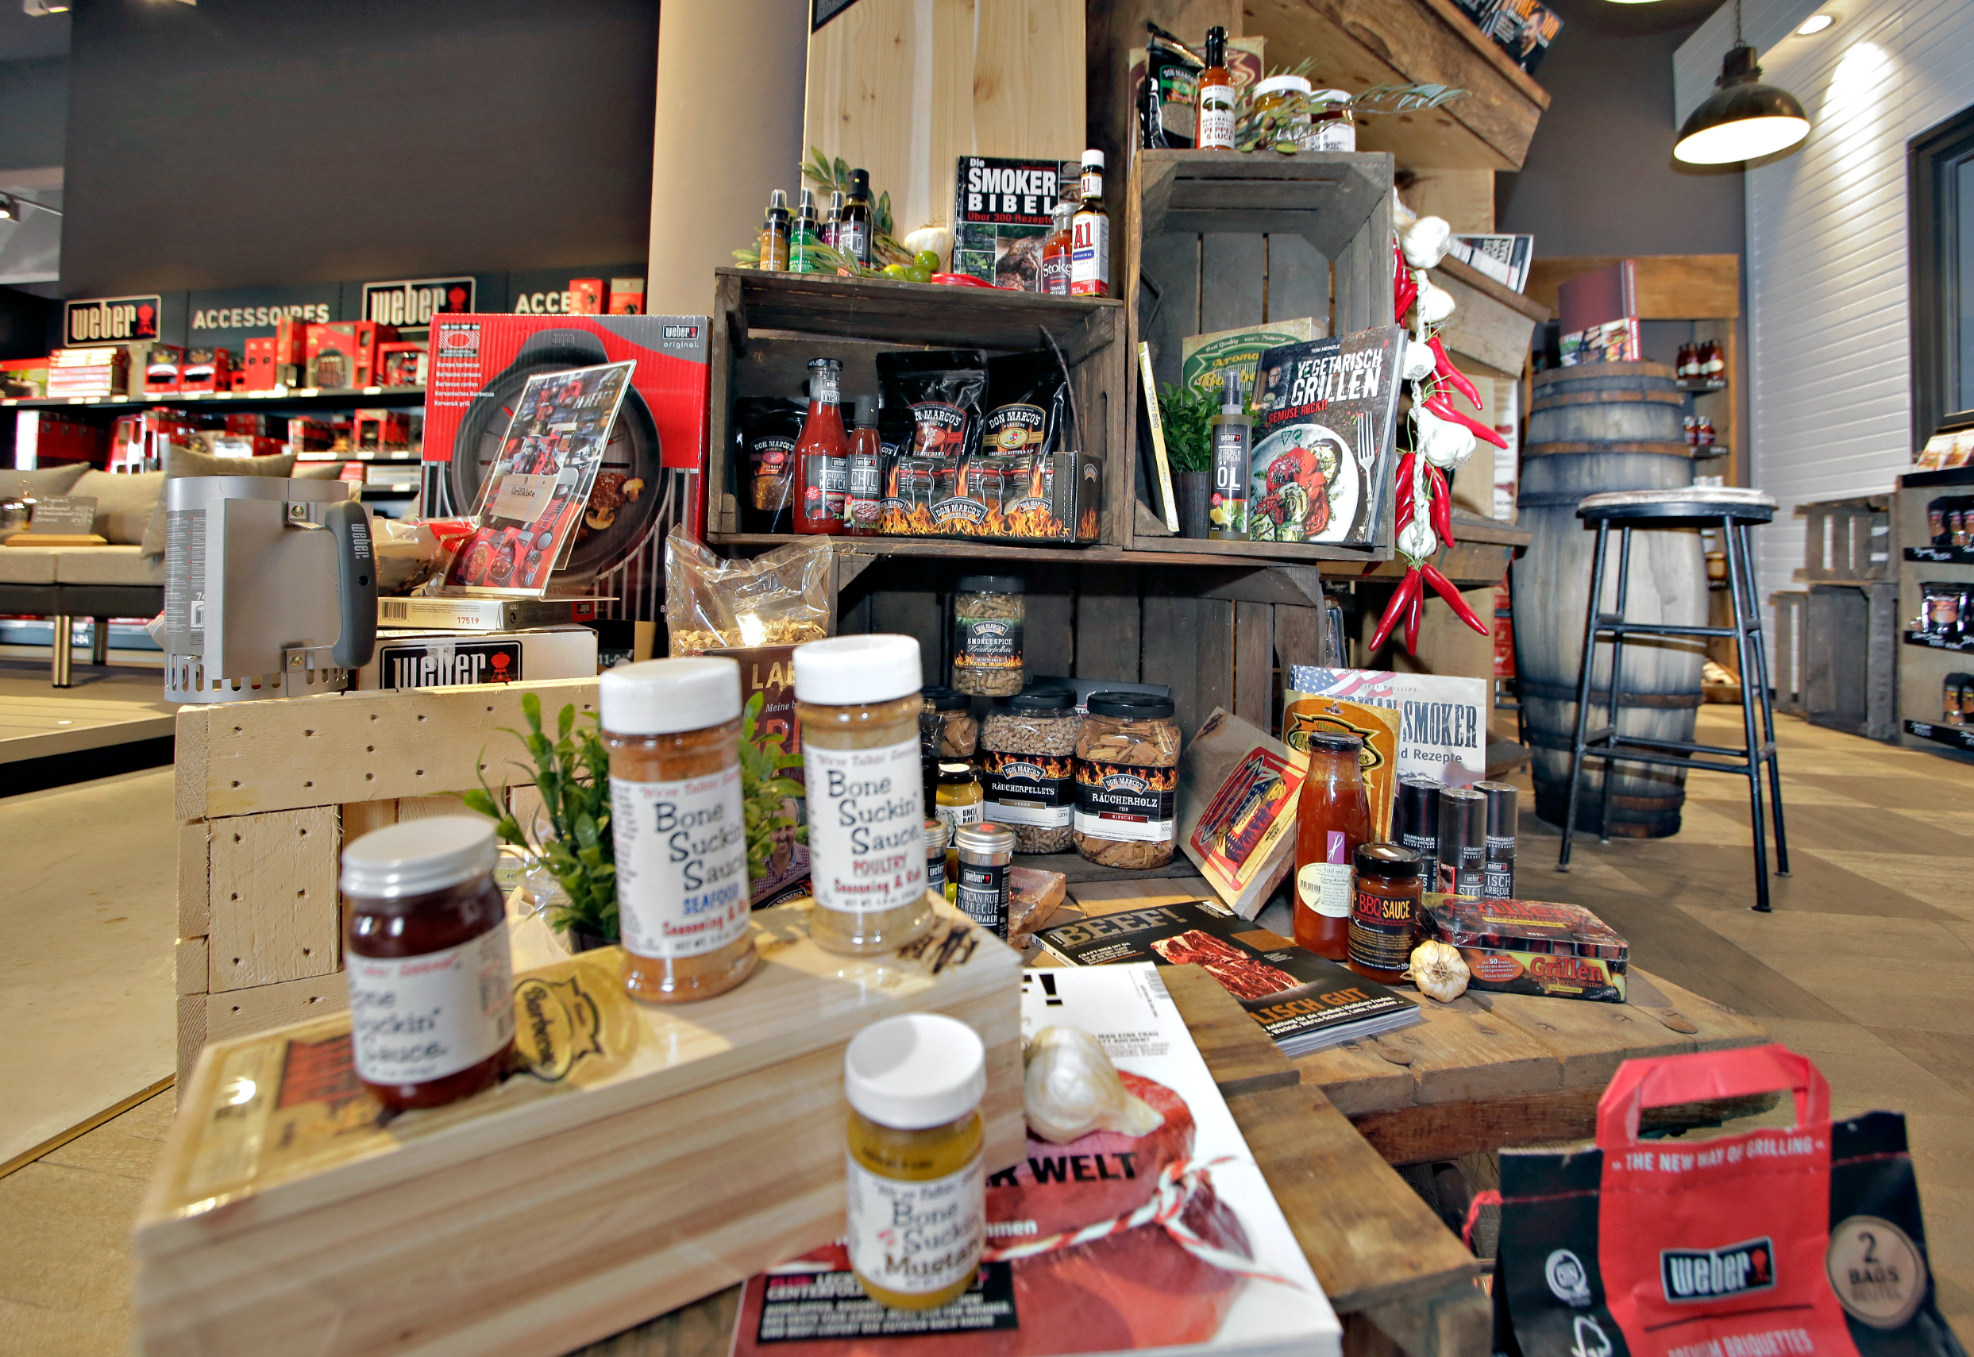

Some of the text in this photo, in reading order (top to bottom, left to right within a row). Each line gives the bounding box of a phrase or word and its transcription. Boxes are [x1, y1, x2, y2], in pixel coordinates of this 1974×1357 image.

[970, 158, 985, 167] Die
[968, 168, 1056, 196] SMOKER
[968, 193, 1054, 215] BIBEL
[968, 211, 990, 221] Über
[994, 213, 1012, 222] 300
[371, 284, 445, 325] weber
[72, 303, 137, 341] weber
[192, 305, 330, 331] ACCESSOIRES
[665, 326, 690, 338] weber
[1219, 339, 1239, 350] Quality
[1261, 334, 1287, 342] Natural
[1212, 352, 1260, 371] Aroma
[1298, 347, 1384, 378] VEGETARISCH
[1291, 366, 1382, 407] GRILLEN
[924, 410, 962, 427] MARCO'S
[988, 411, 1042, 430] DON MARCO'S
[1217, 460, 1241, 488] ÖL
[936, 504, 982, 518] DON MARCO'S
[350, 523, 370, 559] weber
[457, 616, 480, 625] 17519
[993, 638, 1013, 646] SPICE
[393, 653, 487, 689] weber
[1383, 685, 1418, 693] PHILLIPS
[765, 702, 788, 714] Meine
[1402, 699, 1478, 749] SMOKER
[1413, 748, 1463, 765] Rezepte
[1006, 764, 1042, 779] DON MARCO'S
[827, 769, 892, 798] Bone
[991, 782, 1056, 797] RÄUCHERPELLETS
[1106, 776, 1145, 791] DON MARCO'S
[838, 791, 920, 828] Suckin'
[1092, 793, 1158, 808] RÄUCHERHOLZ
[653, 801, 725, 834] Bone
[852, 852, 908, 877] POULTRY
[833, 878, 889, 895] Seasoning
[894, 875, 903, 889] &
[965, 871, 985, 882] weber
[683, 882, 741, 916] SEAFOOD
[958, 888, 999, 905] AFRICAN RUB
[958, 900, 998, 915] BARBECUE
[662, 914, 725, 938] Seasoning
[1052, 907, 1188, 948] BEEF!
[1489, 957, 1498, 965] 50
[1530, 956, 1604, 982] Grillen
[1532, 976, 1547, 984] wie
[1559, 979, 1602, 989] Weltmeister
[1319, 987, 1370, 1006] GUT
[1626, 1136, 1813, 1173] THE NEW WAY OF GRILLING
[1027, 1150, 1138, 1185] WELT
[891, 1200, 958, 1228] Bone
[1854, 1231, 1878, 1265] 2
[1669, 1249, 1751, 1296] weber
[1848, 1265, 1900, 1286] BAGS
